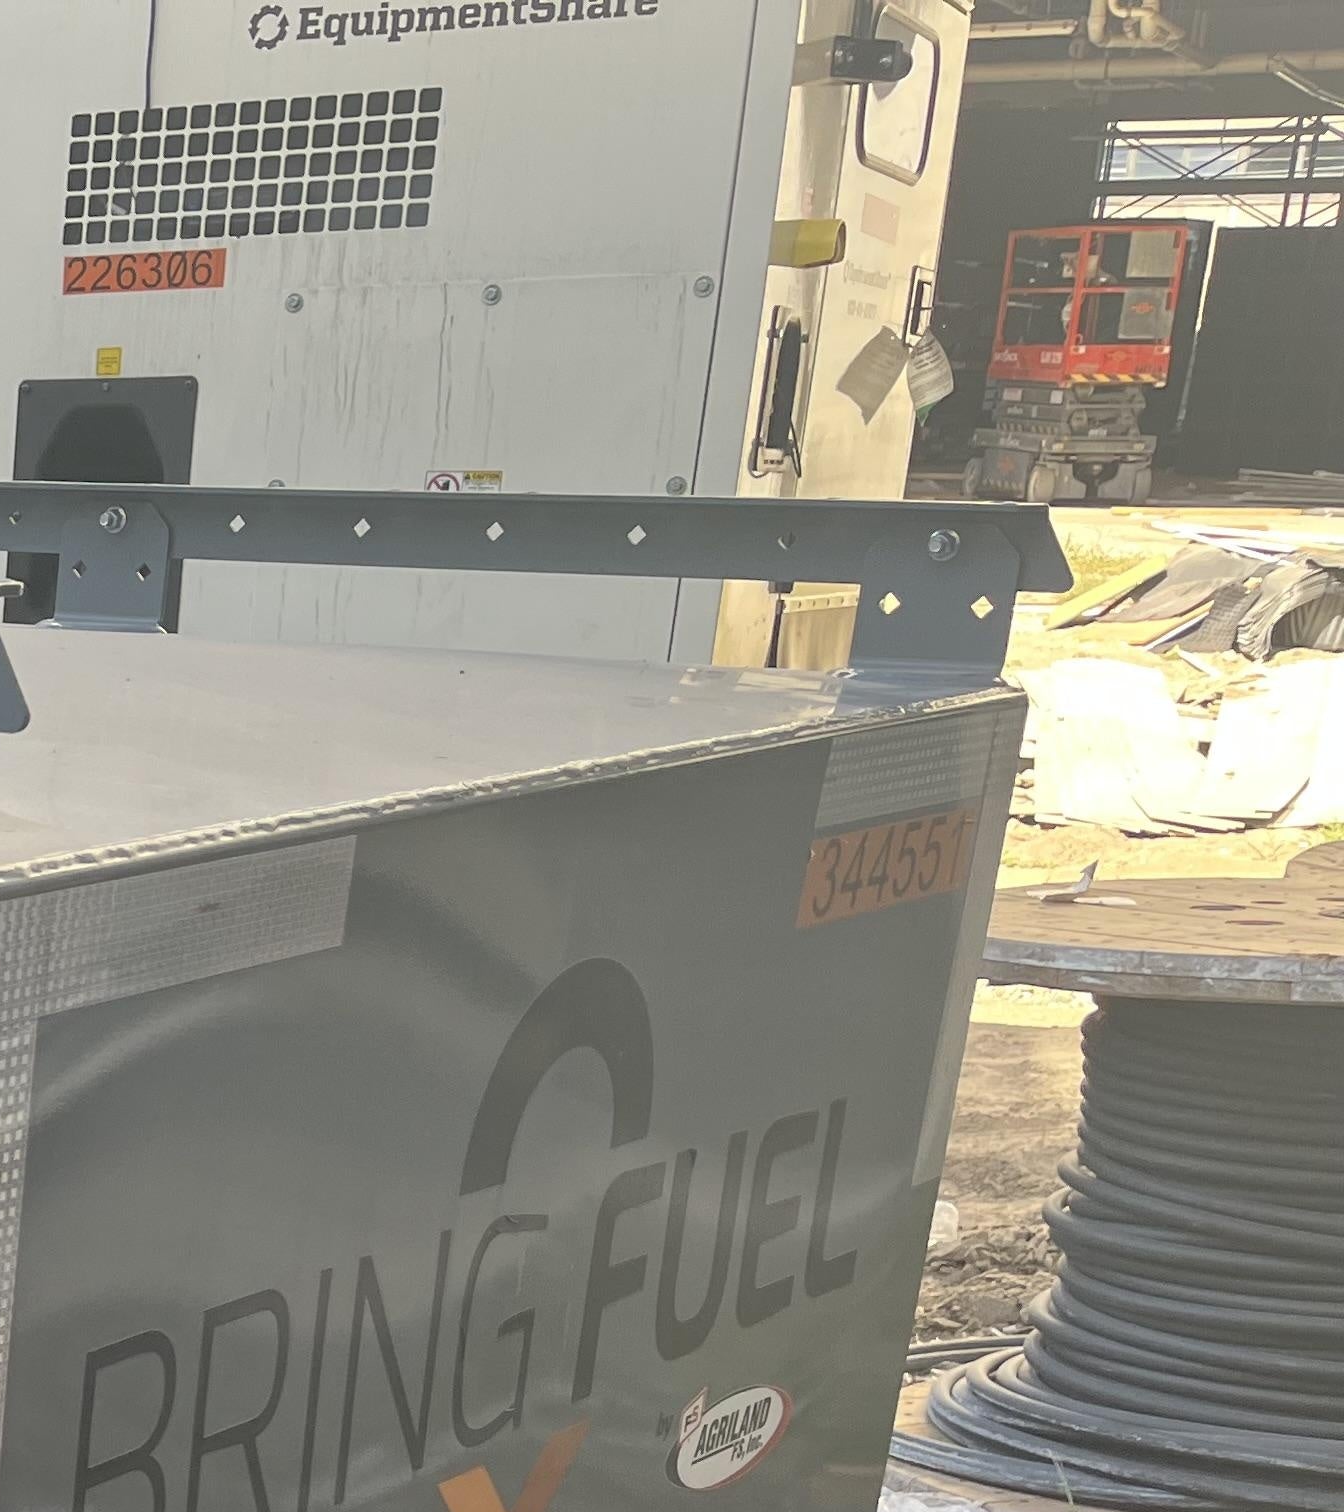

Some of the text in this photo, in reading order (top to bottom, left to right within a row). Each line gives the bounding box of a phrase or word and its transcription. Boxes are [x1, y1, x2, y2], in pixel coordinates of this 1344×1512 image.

[296, 0, 659, 46] EquipmentShare
[66, 249, 213, 292] 226306
[813, 816, 968, 917] 344551
[573, 1097, 857, 1402] FUEL
[683, 1405, 700, 1433] FS
[693, 1396, 772, 1458] AGRILAND
